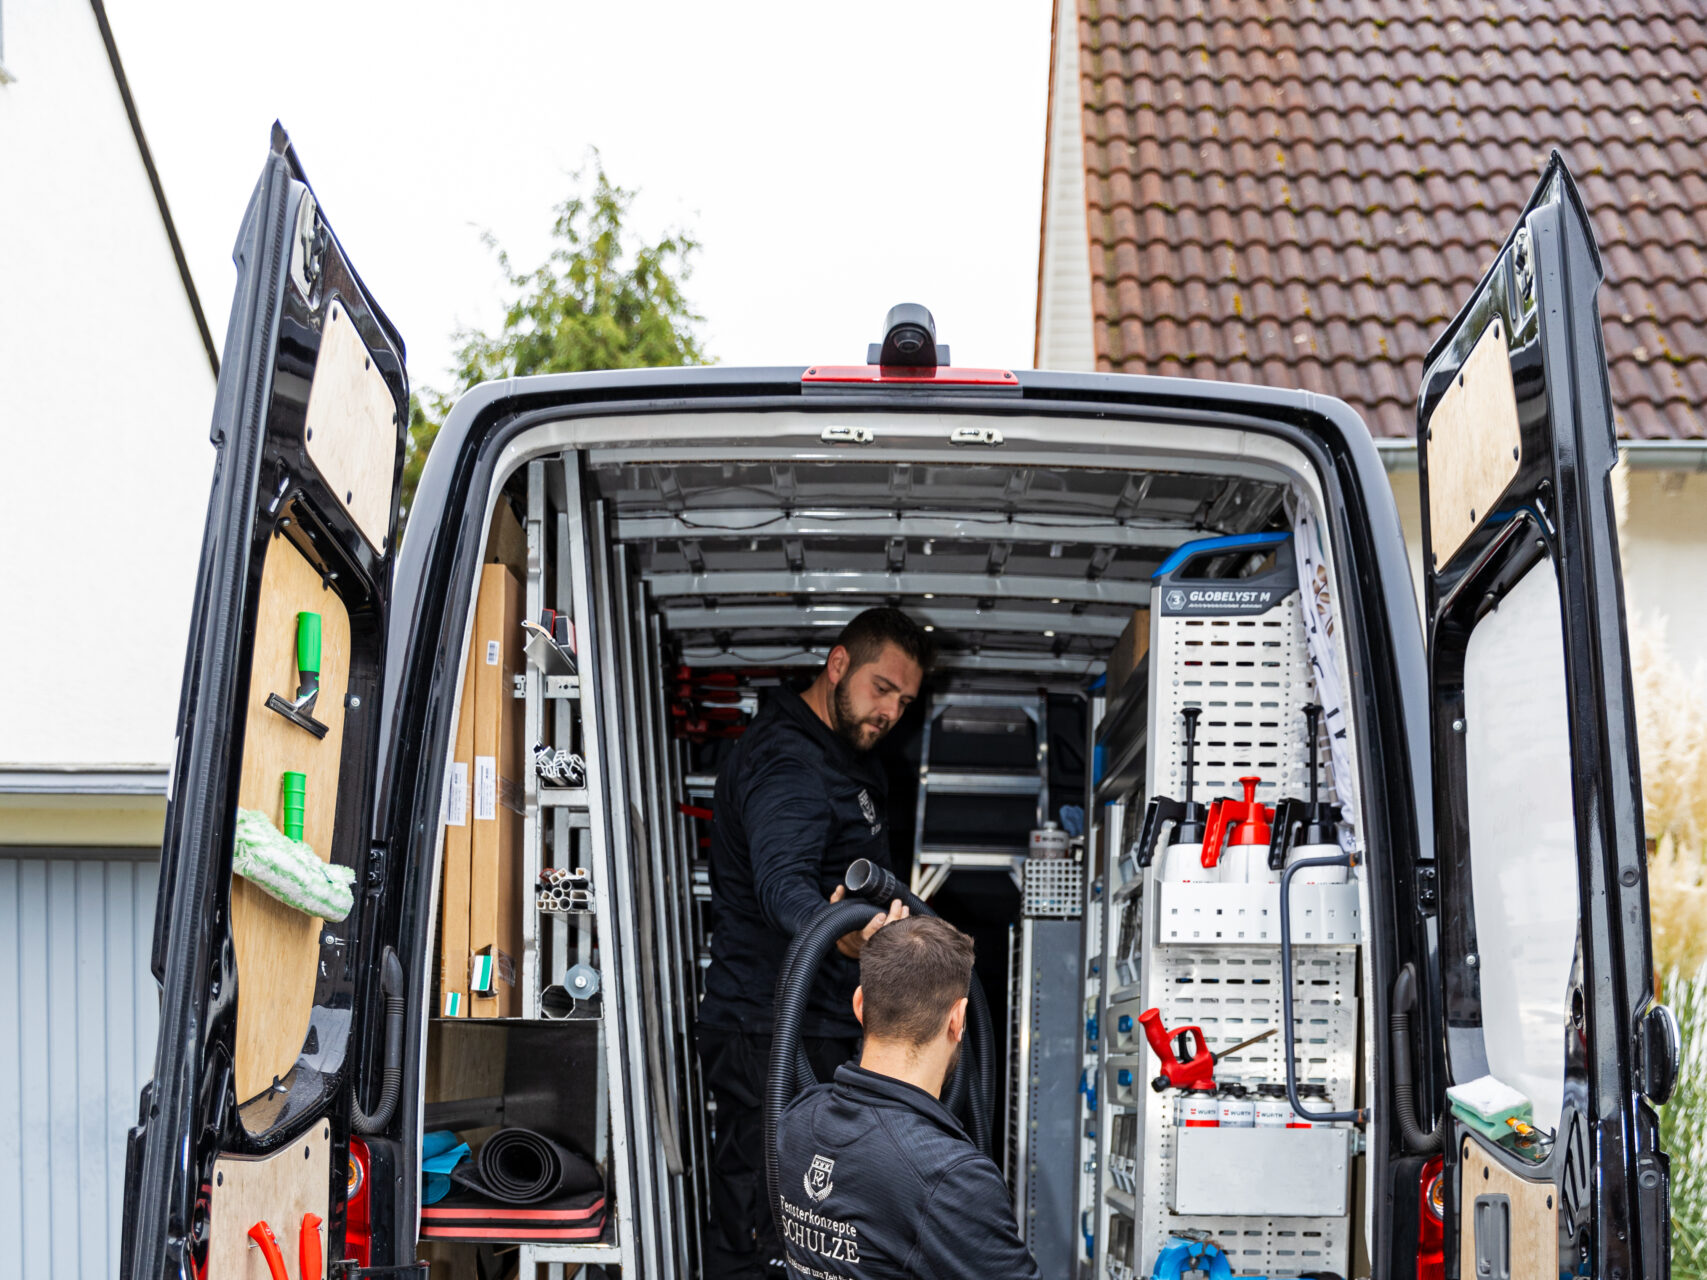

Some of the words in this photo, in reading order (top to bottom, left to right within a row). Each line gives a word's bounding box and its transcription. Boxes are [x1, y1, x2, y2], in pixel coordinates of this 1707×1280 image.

[1189, 591, 1258, 602] GLOBELYST
[1260, 592, 1271, 602] M
[780, 1194, 857, 1237] Fensterkonzepte
[781, 1215, 860, 1264] SCHULZE
